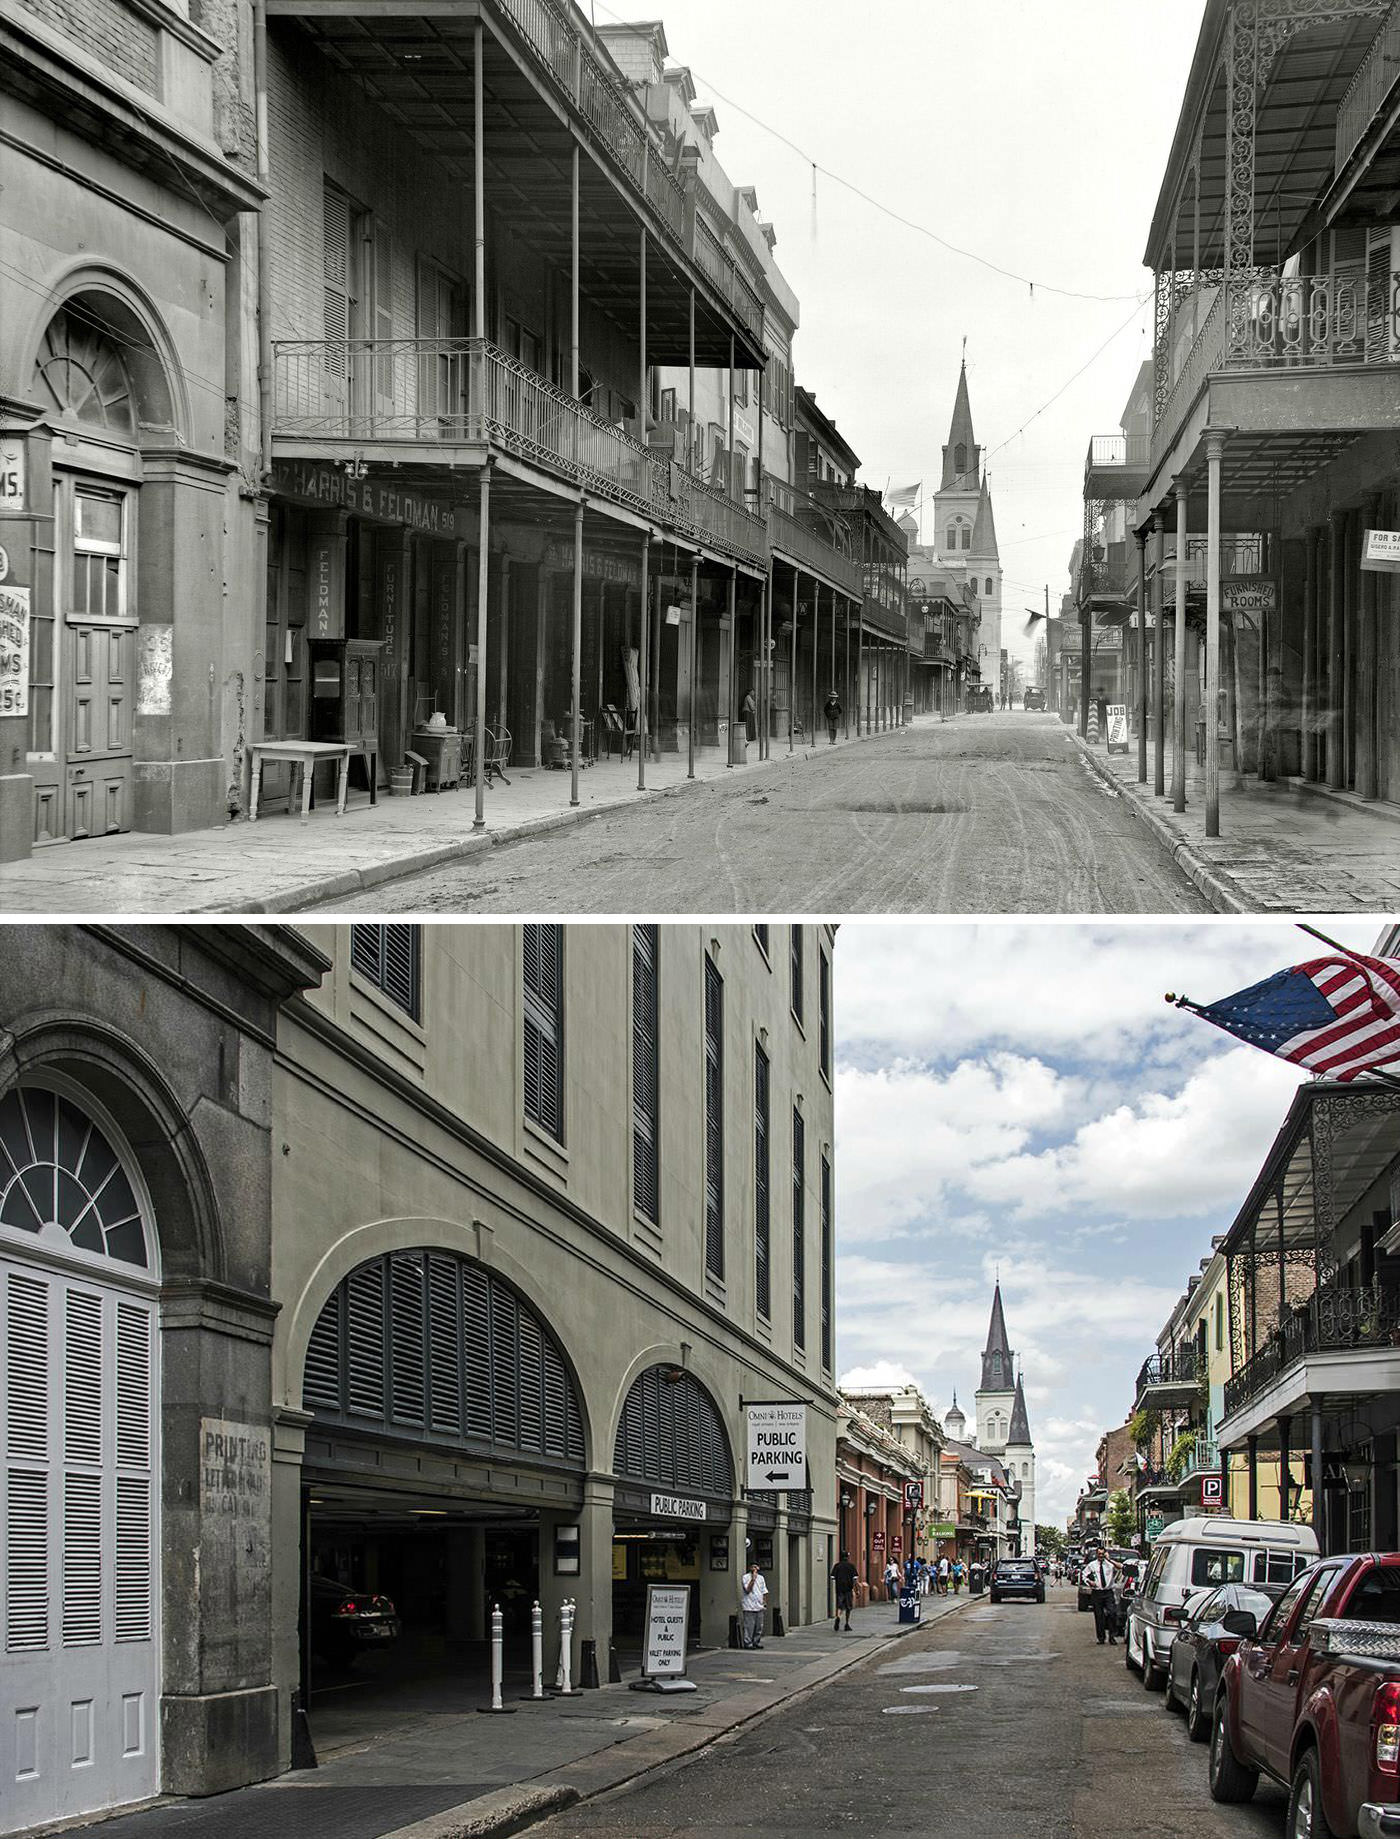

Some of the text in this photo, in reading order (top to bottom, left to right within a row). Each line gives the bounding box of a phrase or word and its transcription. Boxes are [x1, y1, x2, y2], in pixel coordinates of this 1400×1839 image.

[294, 463, 357, 508] HARRIS
[363, 485, 374, 513] &
[379, 490, 438, 531] FELDMAN
[1373, 534, 1389, 542] FOR
[1224, 582, 1274, 599] FURNISHED
[1231, 596, 1271, 607] ROOMS
[385, 564, 396, 655] FURNITURE
[1107, 706, 1125, 716] JOB
[777, 1410, 804, 1420] HOTELS
[757, 1432, 797, 1446] PUBLIC
[751, 1451, 803, 1465] PARKING
[1207, 1481, 1218, 1495] P
[655, 1496, 704, 1519] PUBLIC PARKING
[657, 1634, 675, 1642] PUBLIC
[658, 1659, 671, 1667] ONLY
